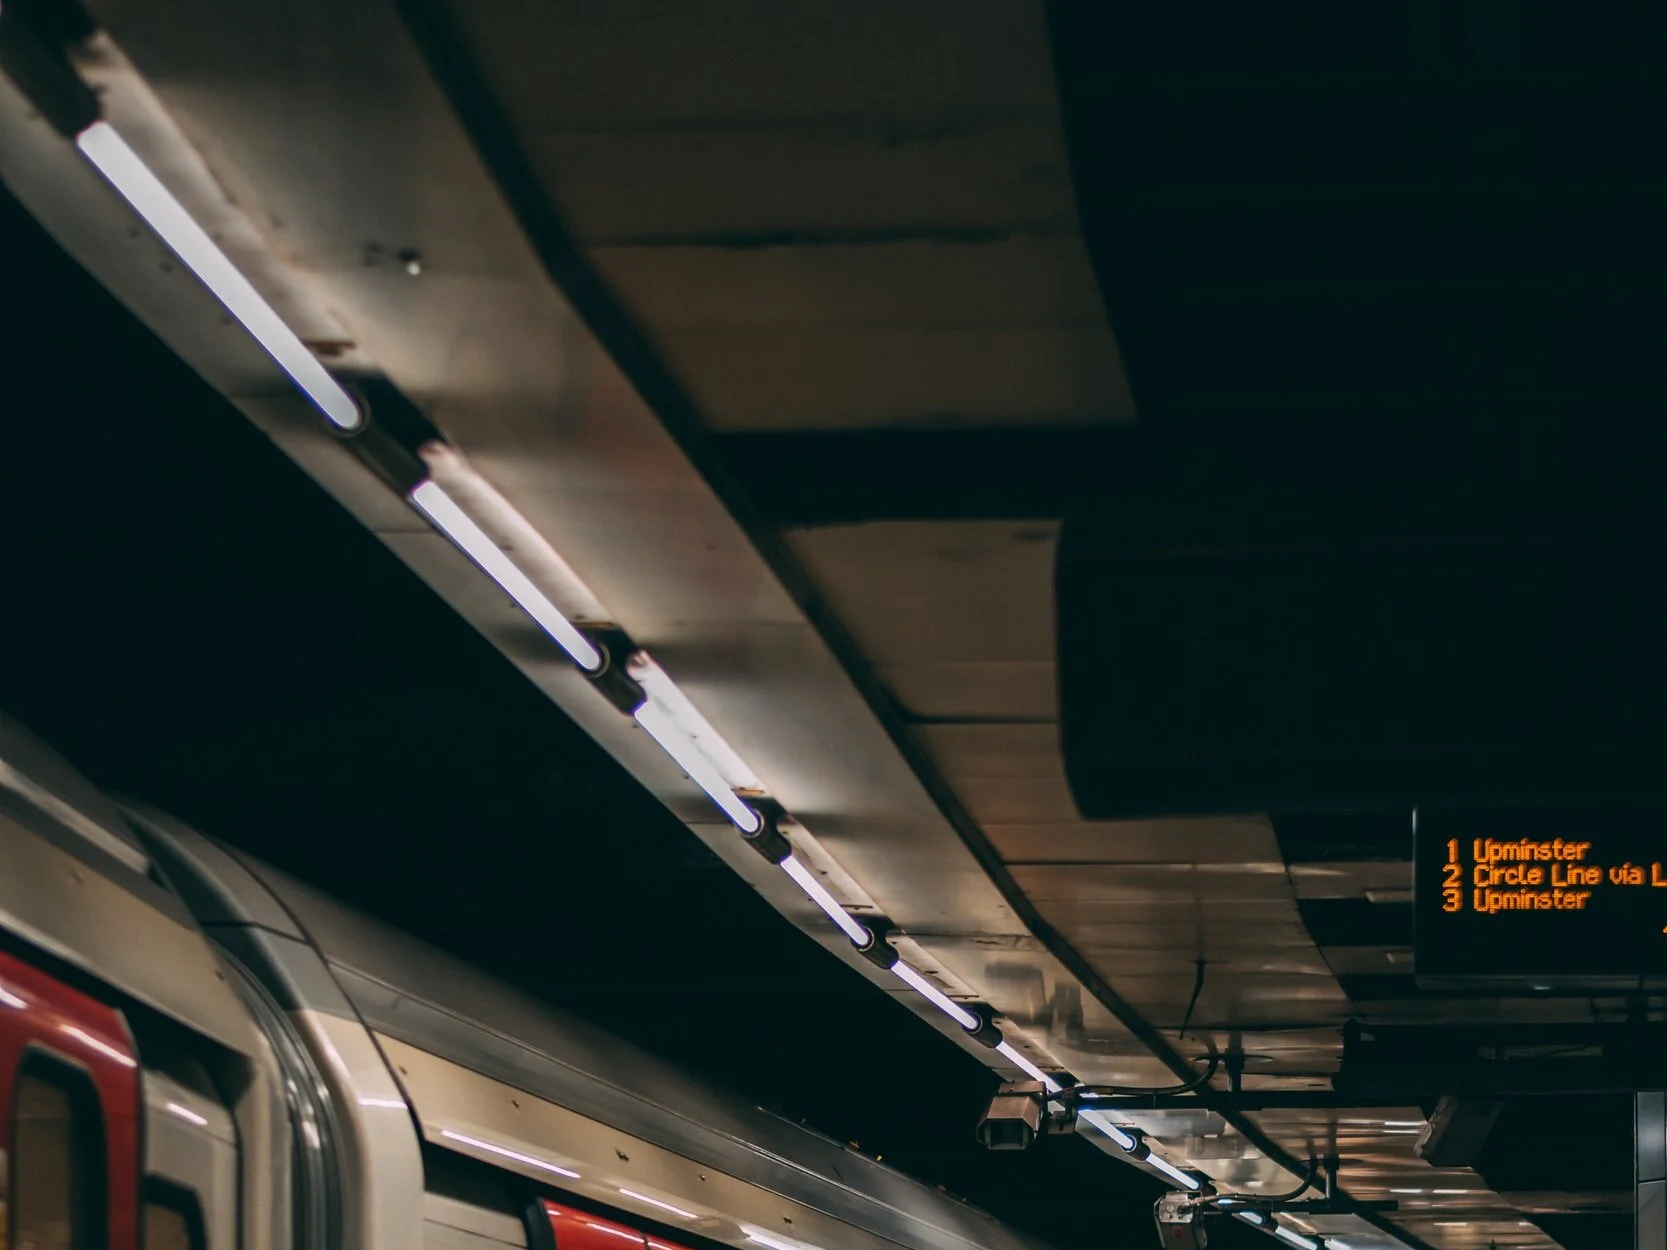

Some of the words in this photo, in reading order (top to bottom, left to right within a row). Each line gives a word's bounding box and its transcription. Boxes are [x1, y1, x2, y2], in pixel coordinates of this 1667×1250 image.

[1446, 837, 1459, 863] 1
[1472, 837, 1592, 865] Upminster
[1442, 862, 1463, 888] 2
[1472, 863, 1546, 888] Circle
[1550, 863, 1603, 888] Line
[1608, 862, 1646, 886] via
[1442, 888, 1463, 913] 3
[1472, 888, 1592, 915] Upminster
